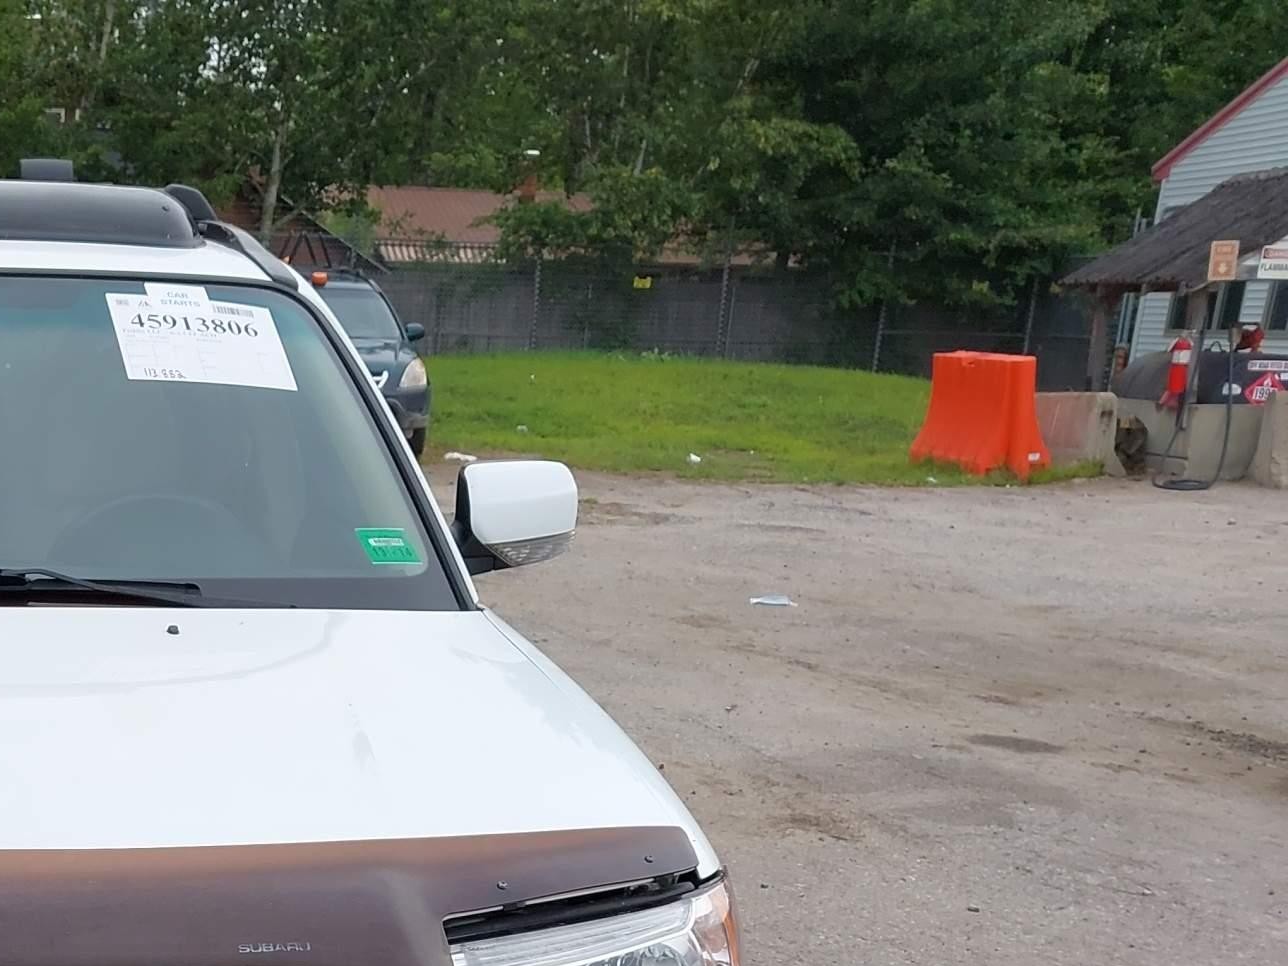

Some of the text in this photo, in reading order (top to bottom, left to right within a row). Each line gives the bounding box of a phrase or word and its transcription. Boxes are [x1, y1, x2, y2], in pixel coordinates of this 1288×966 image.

[167, 291, 189, 299] CAR
[160, 299, 201, 308] STARTS
[130, 313, 259, 338] 45913806
[238, 942, 311, 954] SUBARU
